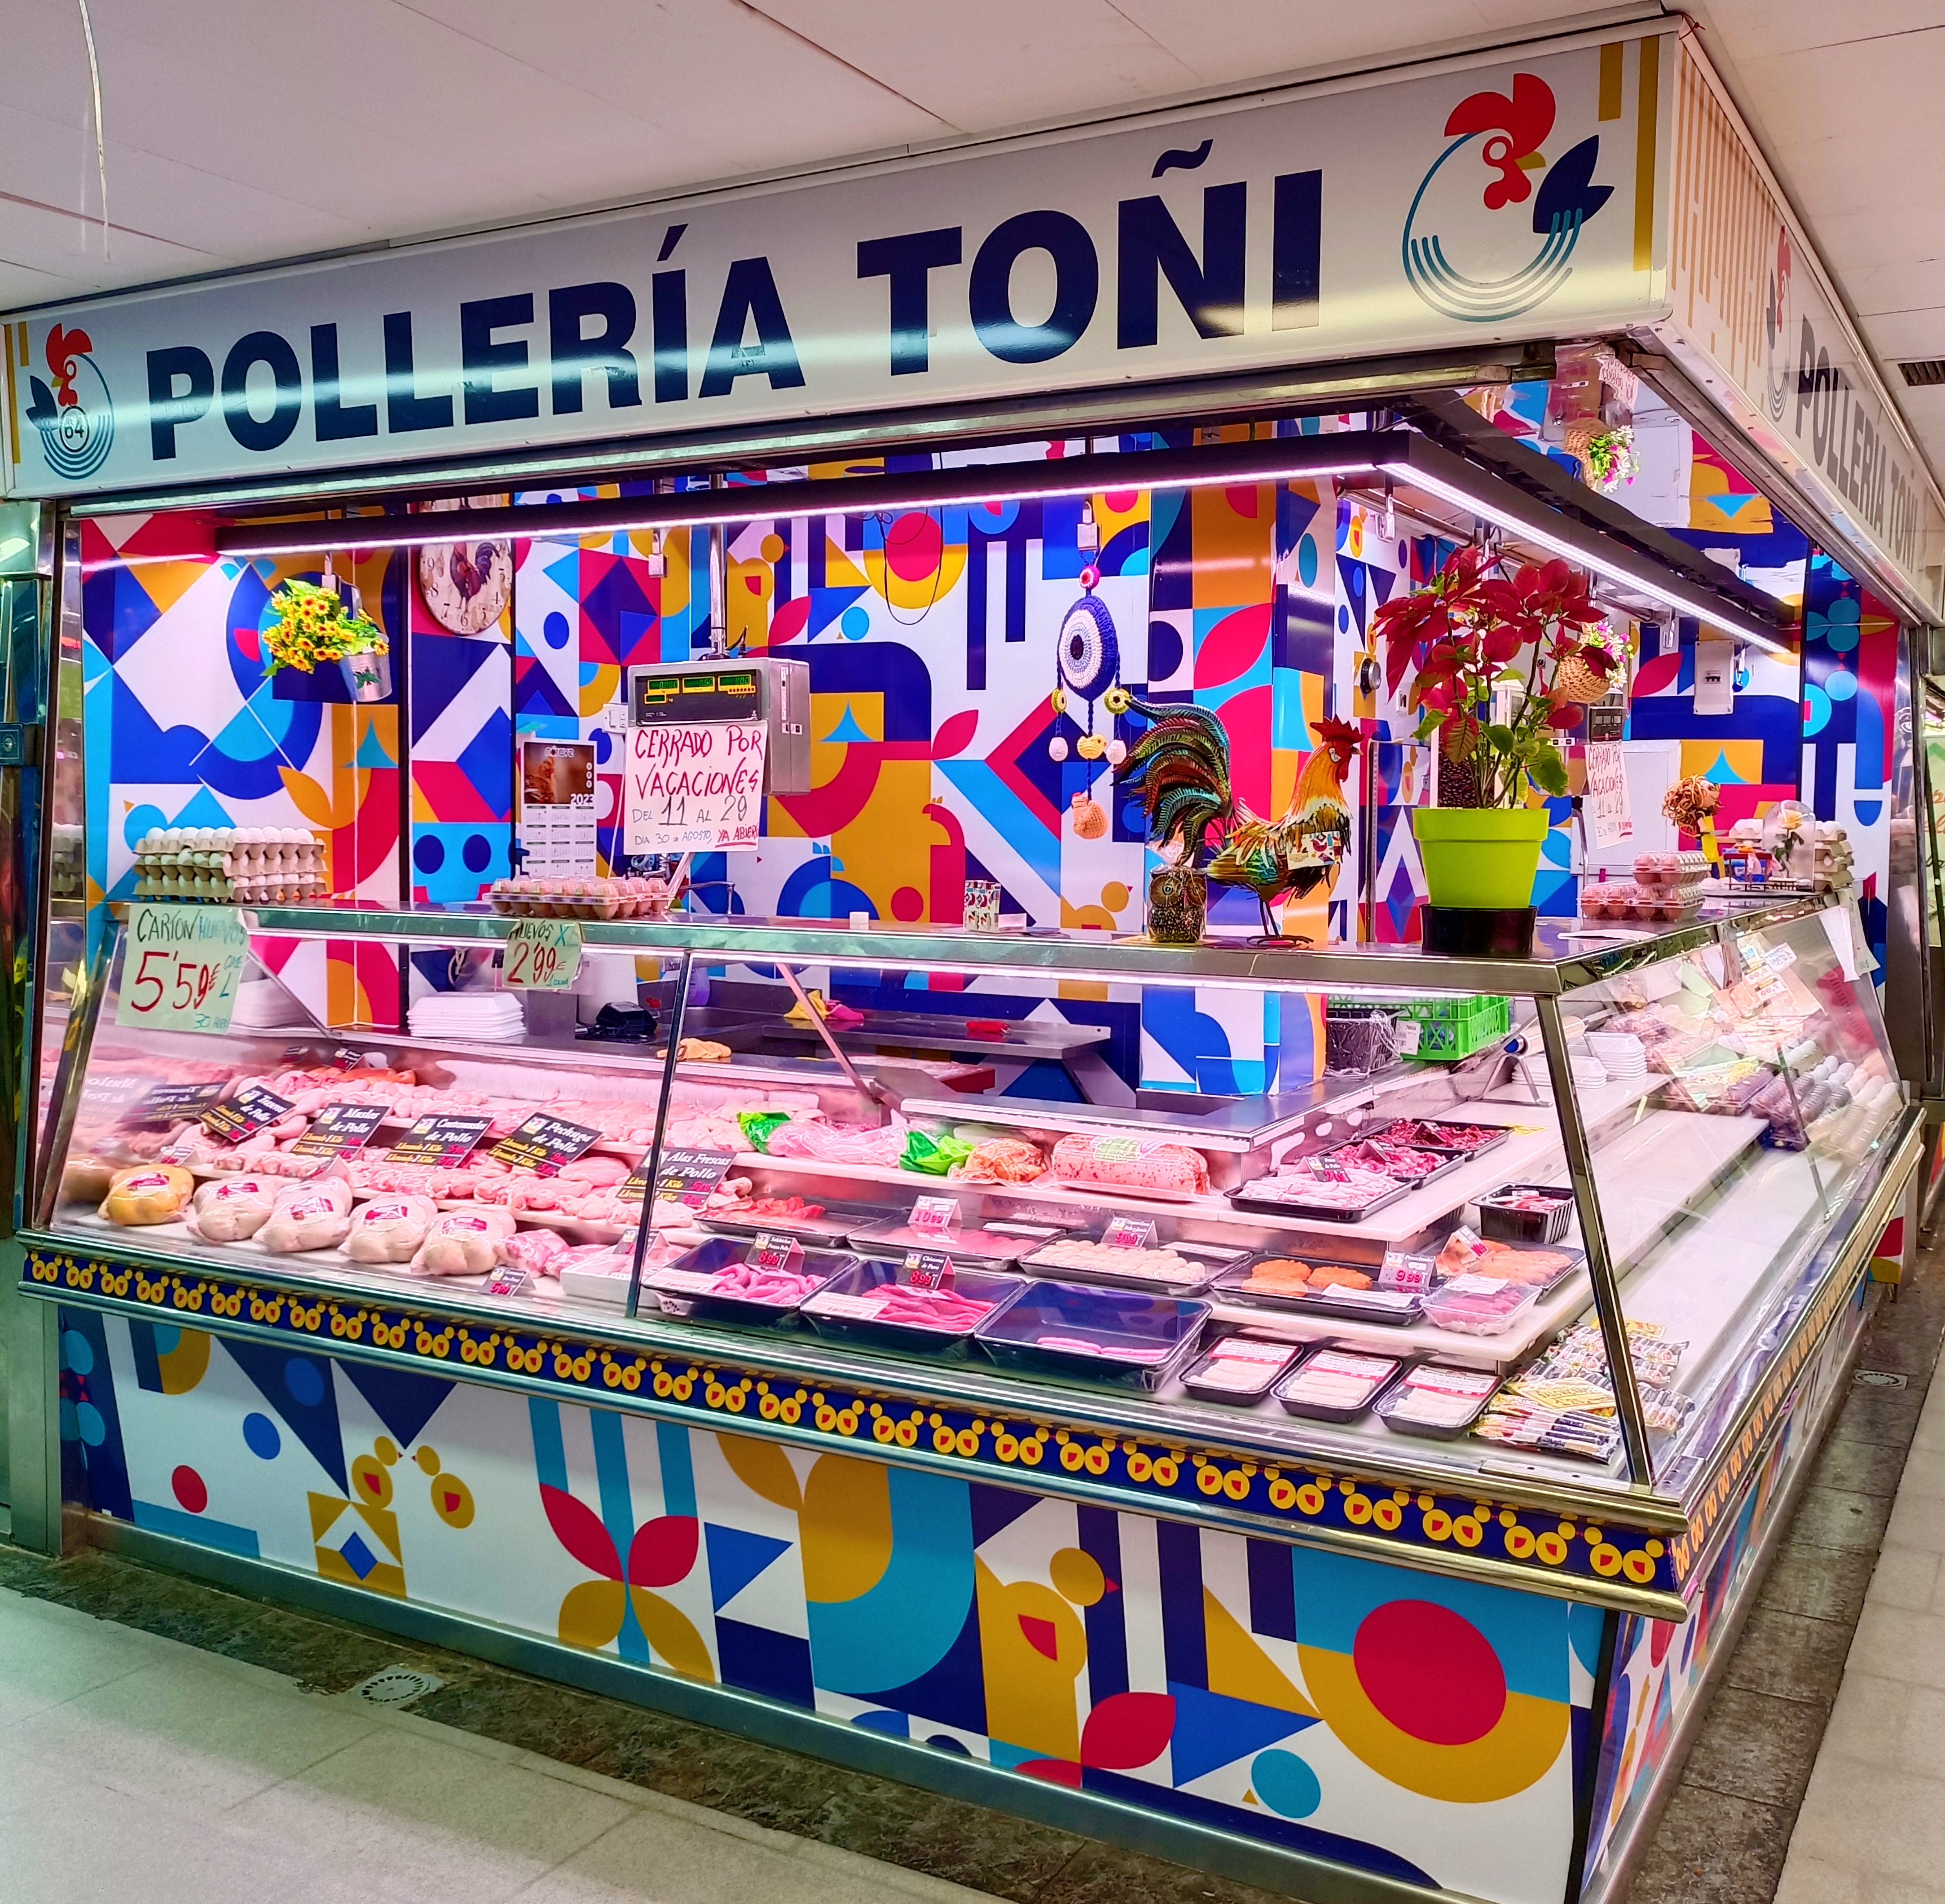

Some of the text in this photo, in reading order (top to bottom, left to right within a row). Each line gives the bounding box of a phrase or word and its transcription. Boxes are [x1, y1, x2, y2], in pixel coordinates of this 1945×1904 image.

[146, 139, 1322, 461] POLLERÍA TOÑI
[635, 729, 712, 768] CERRADO
[635, 757, 759, 800] VACACIONES
[571, 794, 594, 805] 2023
[632, 795, 747, 826] DEL 11 AL 29
[655, 833, 670, 844] 30
[718, 829, 730, 843] YA
[342, 1108, 381, 1120] Muslos
[329, 1121, 371, 1134] de Pollo
[544, 1121, 593, 1143] Pechuga
[424, 1131, 473, 1144] de Pollo
[531, 1134, 579, 1154] de Pollo
[667, 1151, 732, 1166] Alas Frescas
[661, 1165, 718, 1180] de Pollo
[666, 1179, 684, 1189] Kilo
